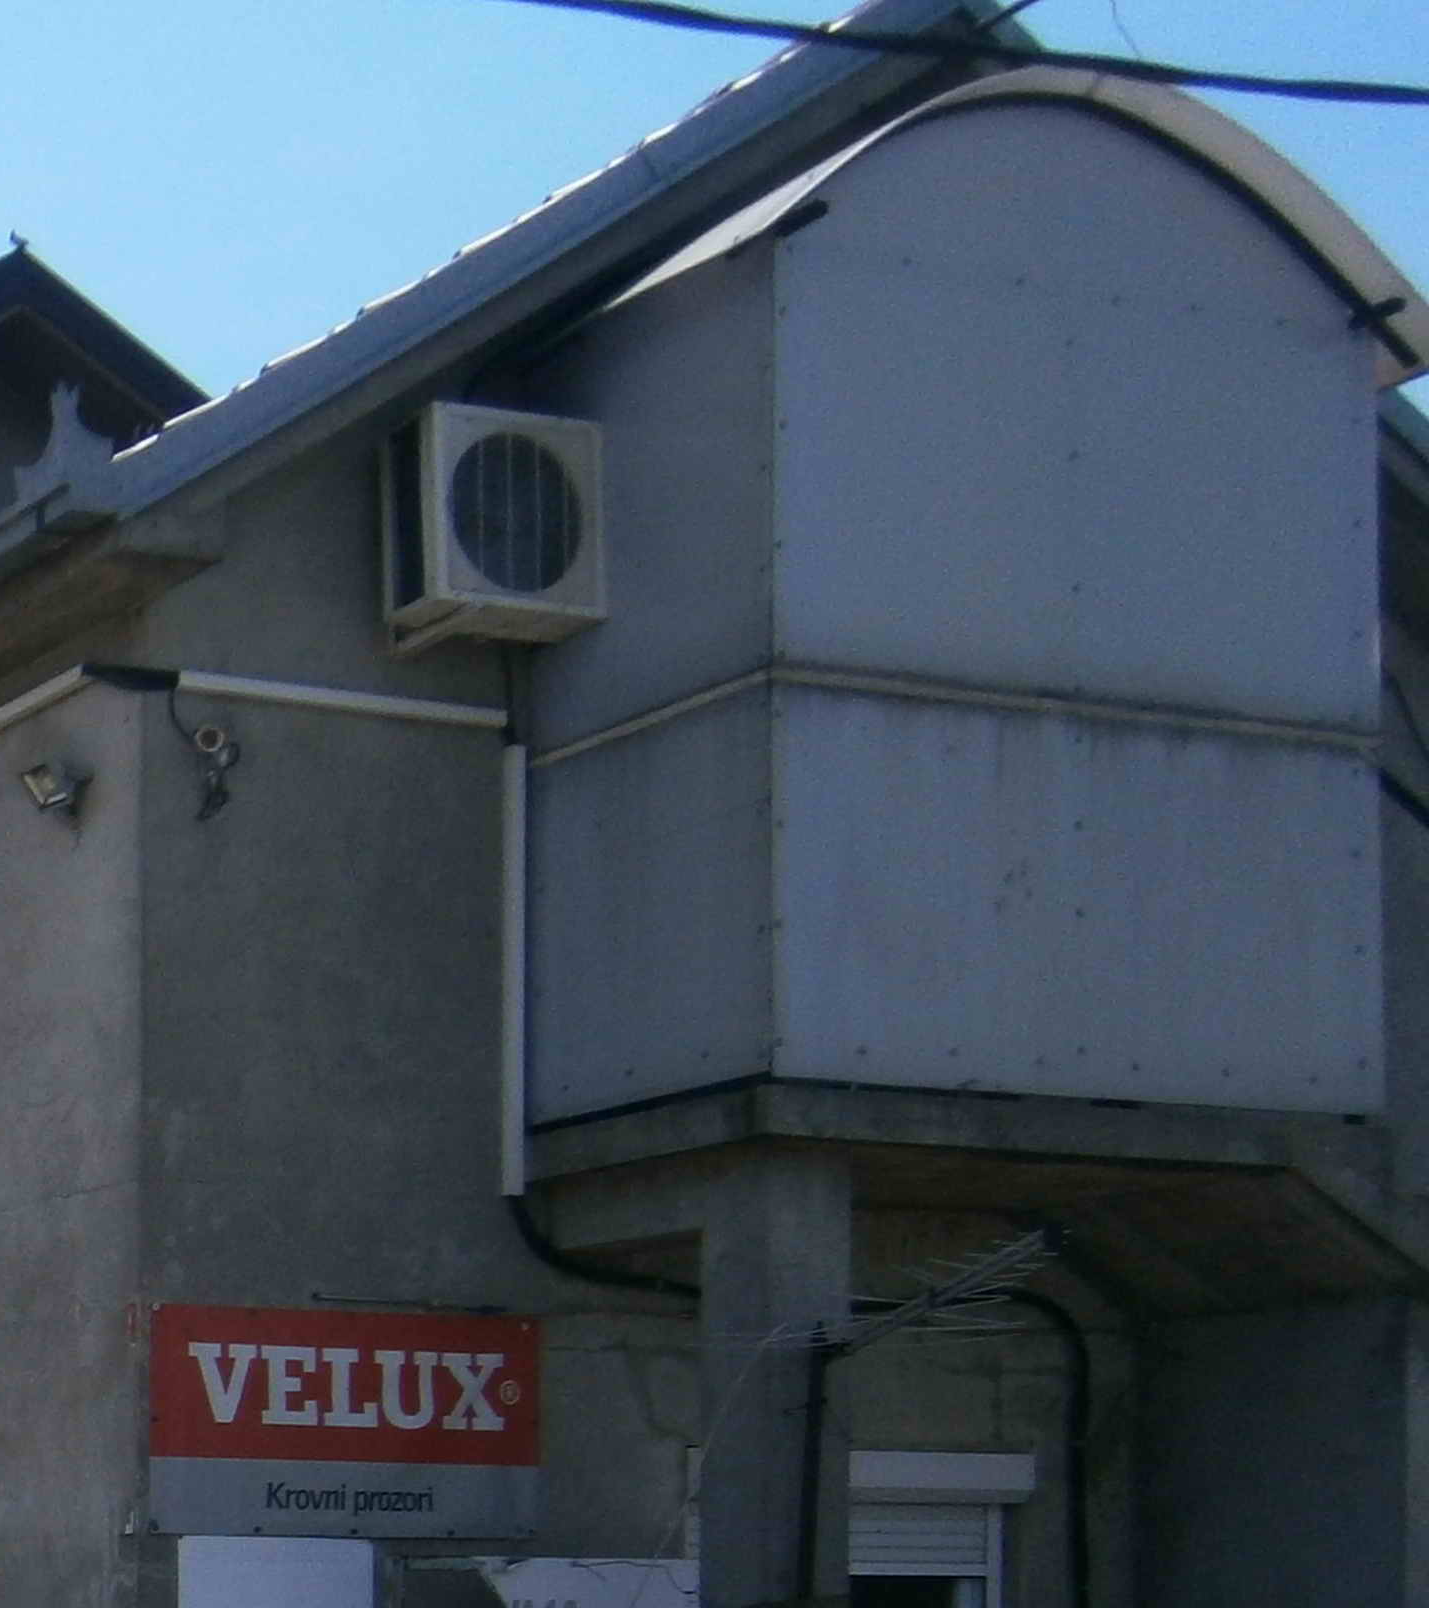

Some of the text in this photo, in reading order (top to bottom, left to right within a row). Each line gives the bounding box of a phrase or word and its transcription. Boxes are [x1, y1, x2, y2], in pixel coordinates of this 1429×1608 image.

[189, 1342, 504, 1431] VELUX
[266, 1482, 433, 1516] Krovni prozori
